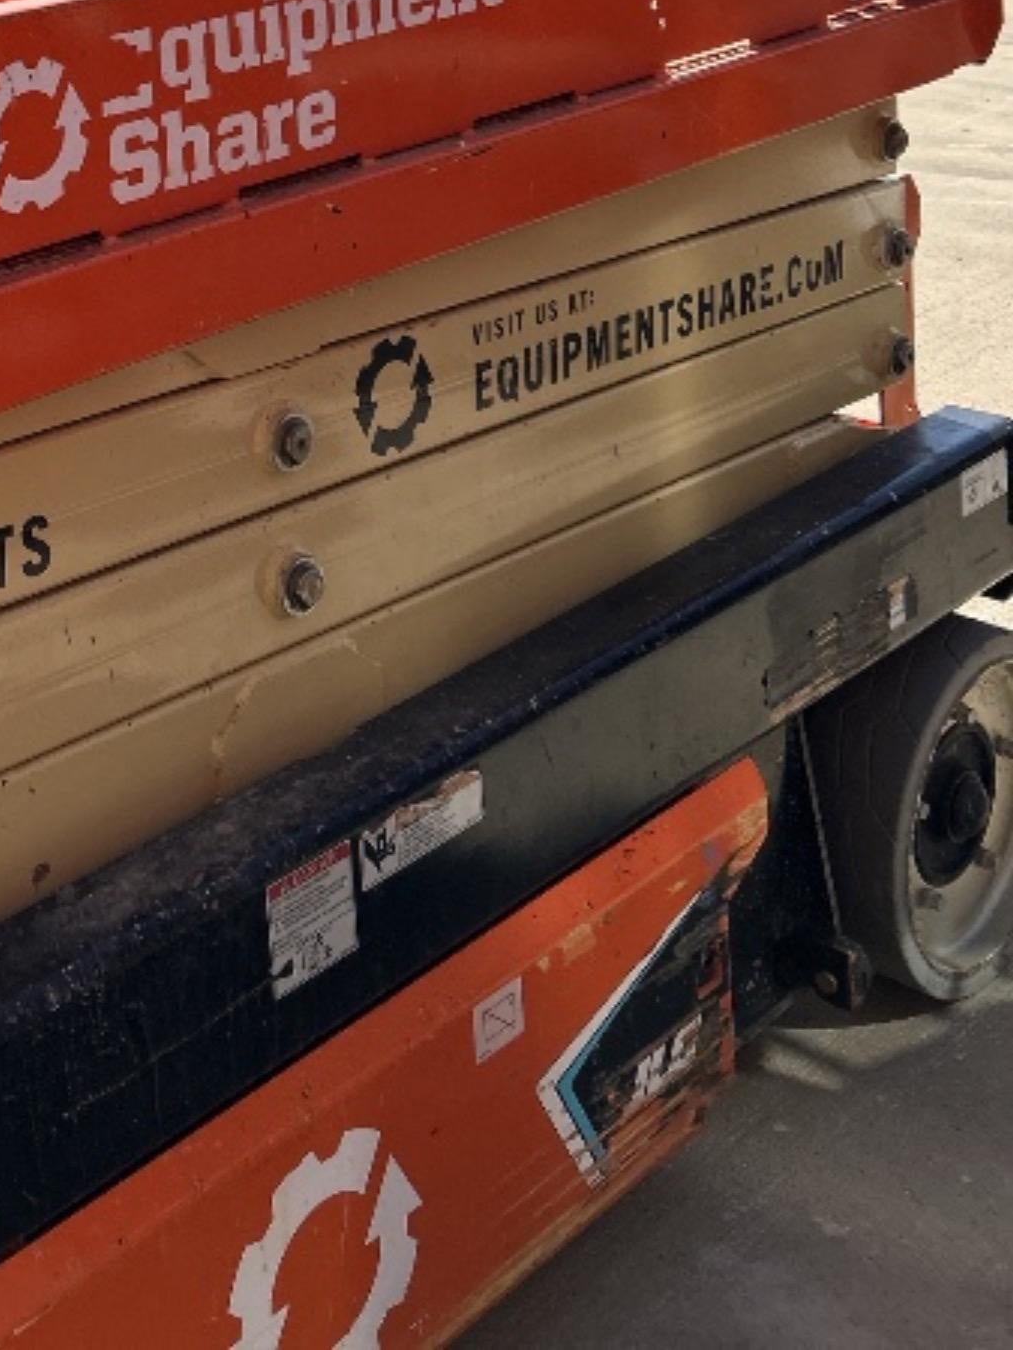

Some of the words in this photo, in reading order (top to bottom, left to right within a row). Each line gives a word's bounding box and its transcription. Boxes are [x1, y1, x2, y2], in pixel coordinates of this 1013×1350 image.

[108, 88, 337, 205] Share
[472, 308, 526, 346] VISIT
[535, 300, 559, 326] US
[567, 289, 595, 315] AT:
